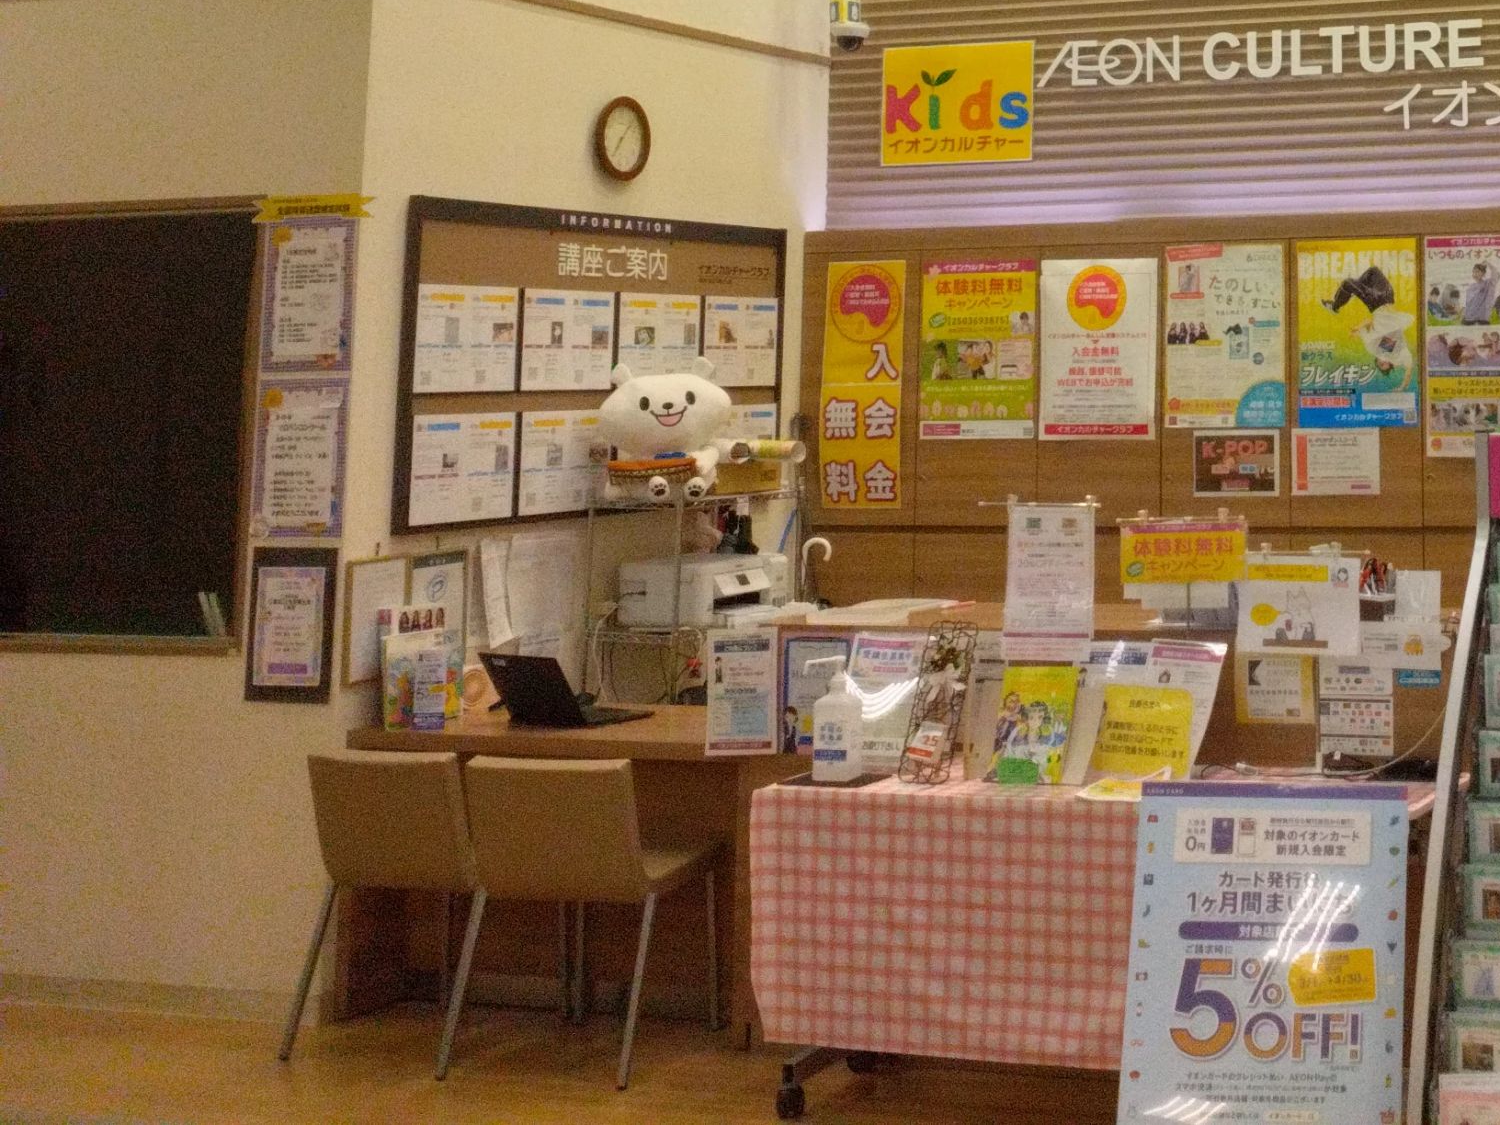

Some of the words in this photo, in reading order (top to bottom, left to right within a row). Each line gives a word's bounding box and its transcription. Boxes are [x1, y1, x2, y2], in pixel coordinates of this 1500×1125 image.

[1202, 18, 1485, 81] CULTURE
[888, 135, 1025, 155] イオンカルチャー
[561, 214, 673, 234] INFORMATION
[557, 242, 669, 281] 講座ご案内
[1297, 250, 1415, 279] BREAKING
[936, 278, 1023, 297] 体験料無料
[944, 296, 1014, 310] キャンペーン
[1202, 440, 1268, 458] K-POP
[1134, 536, 1233, 557] 体験料無料
[1147, 559, 1225, 572] キャンペーン
[1263, 829, 1360, 843] 対象のイオンカード
[1275, 843, 1347, 857] 新規入会限定
[1169, 956, 1284, 1060] 5%
[1242, 1010, 1362, 1061] OFF!
